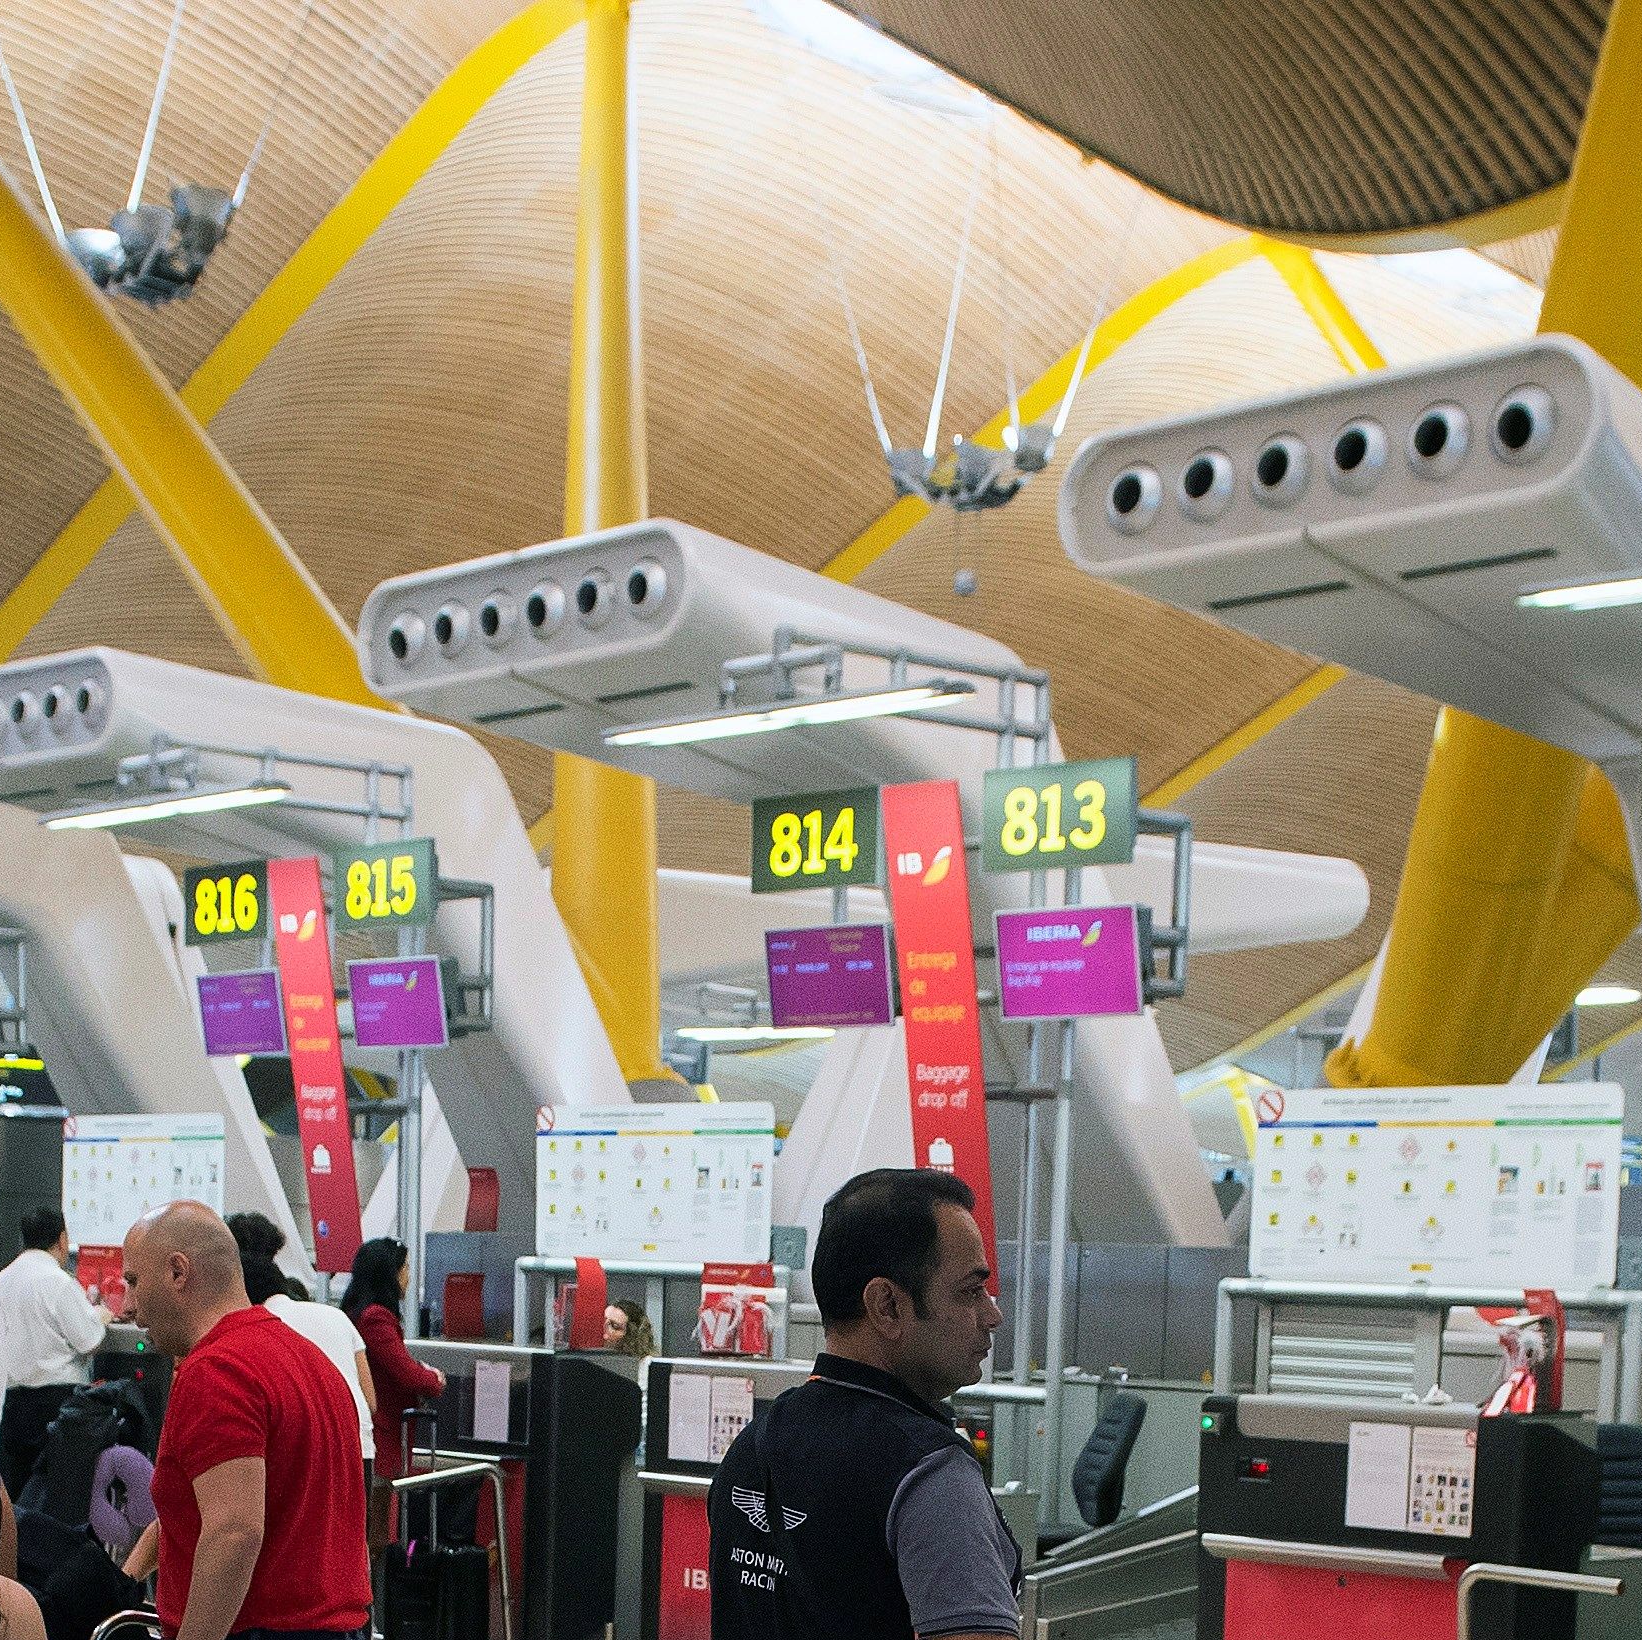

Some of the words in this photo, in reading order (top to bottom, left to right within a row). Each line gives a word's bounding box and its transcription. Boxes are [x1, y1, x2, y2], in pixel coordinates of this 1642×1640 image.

[769, 808, 858, 877] 814
[1001, 779, 1107, 856] 813
[345, 854, 417, 920] 815
[896, 852, 922, 876] IB
[194, 873, 259, 935] 816
[731, 1547, 765, 1568] ASTON
